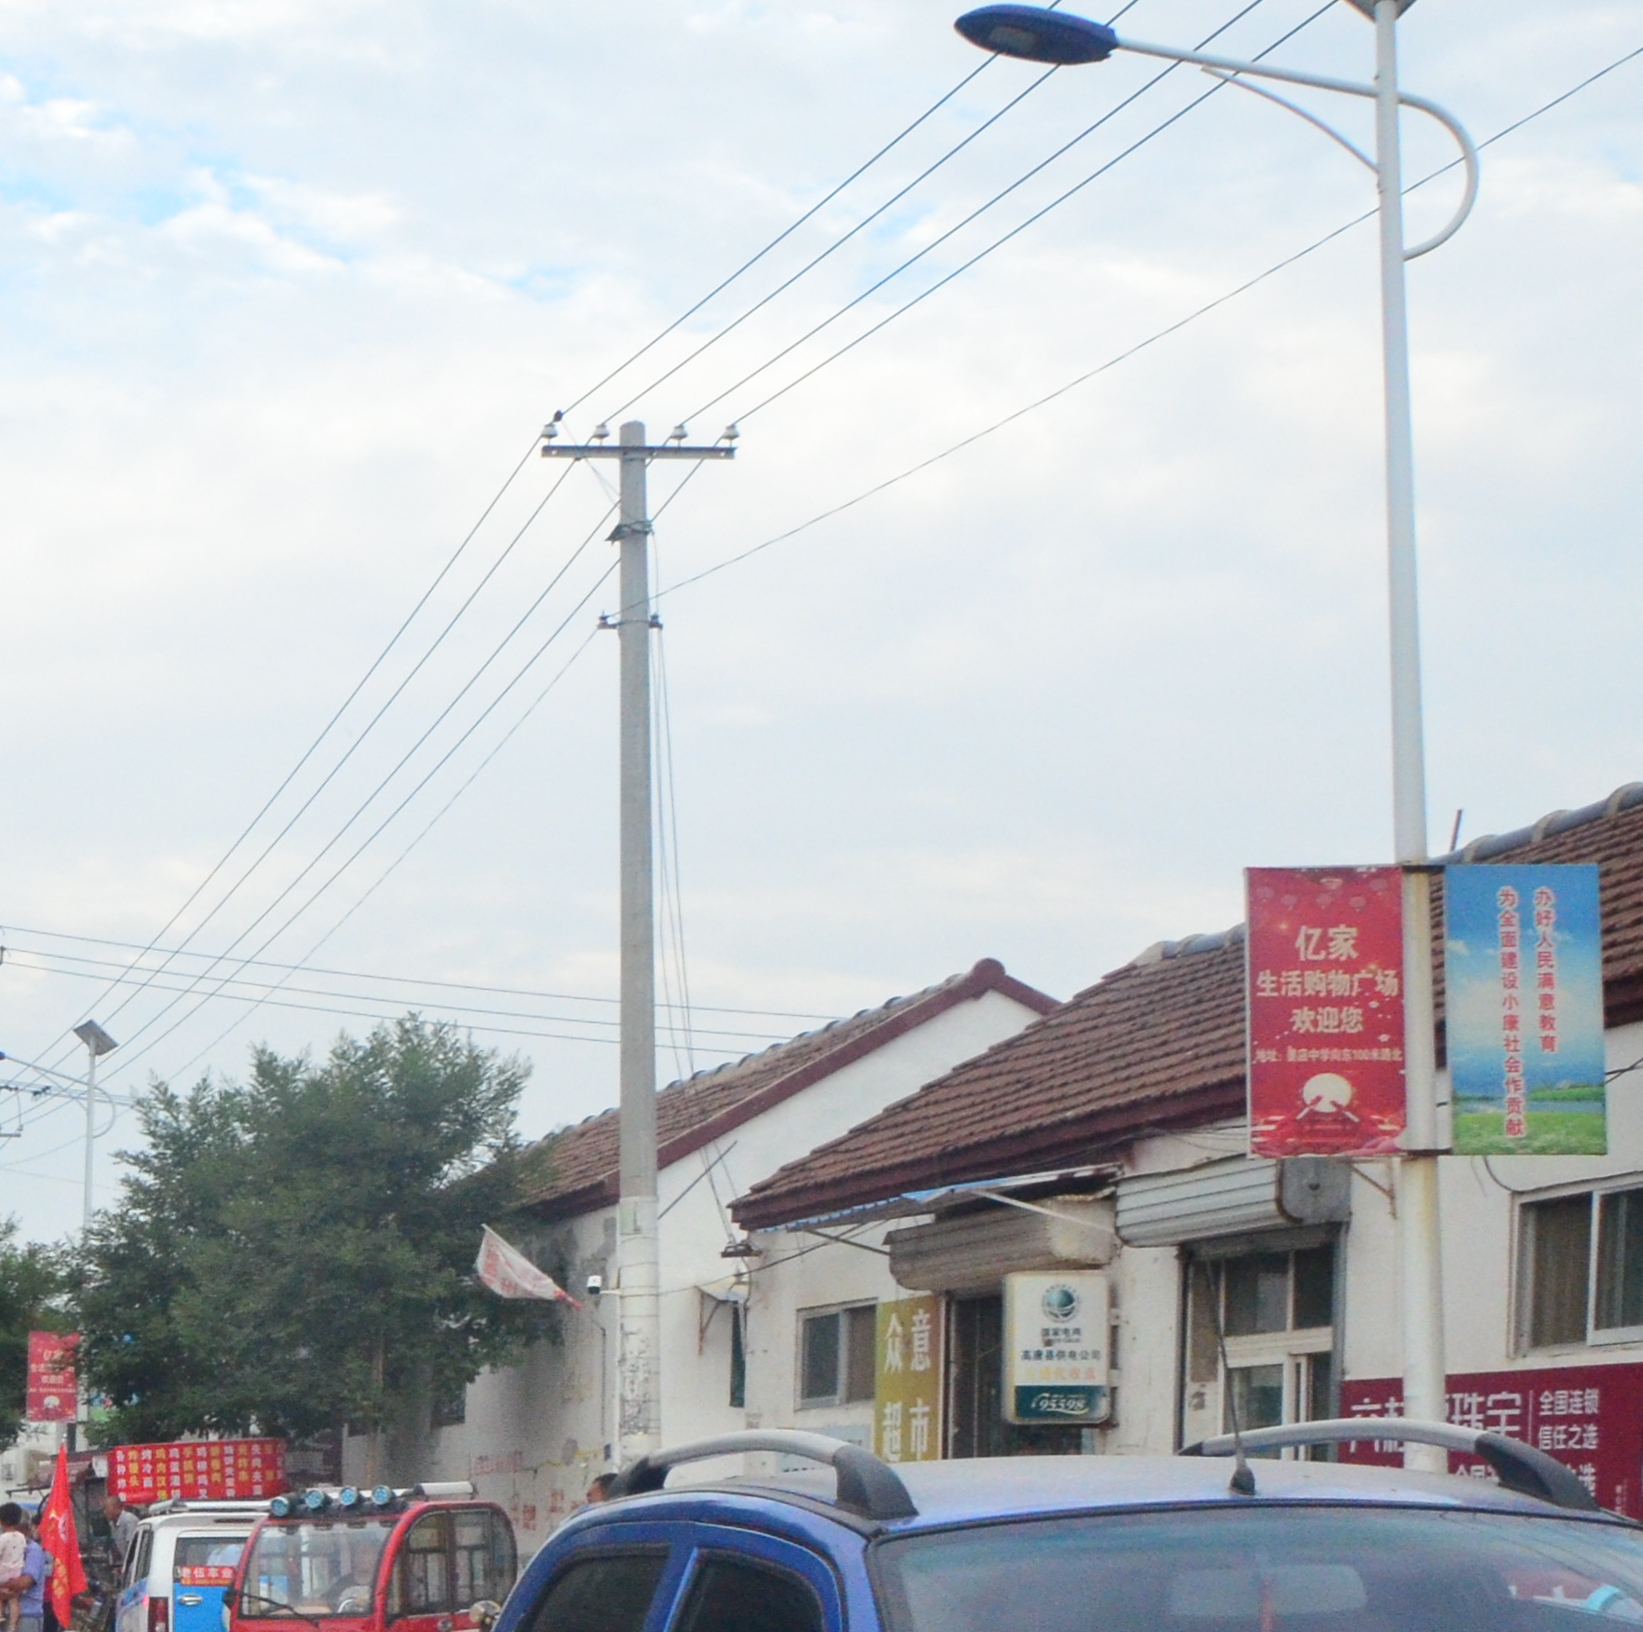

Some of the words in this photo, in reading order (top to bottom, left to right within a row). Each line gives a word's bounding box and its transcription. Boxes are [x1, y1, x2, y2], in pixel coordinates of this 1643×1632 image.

[1295, 925, 1360, 962] 亿家
[1256, 969, 1400, 999] 生活购物广场
[1534, 887, 1557, 1053] 办好人民满意教育
[1290, 1006, 1365, 1034] 欢迎您
[1497, 886, 1525, 1138] 为全面建设小康社会作贡献
[883, 1308, 932, 1374] 众意
[1038, 1399, 1087, 1411] 95598
[1538, 1387, 1600, 1416] 全国连锁
[882, 1398, 932, 1463] 超市
[1537, 1424, 1600, 1450] 信任之选
